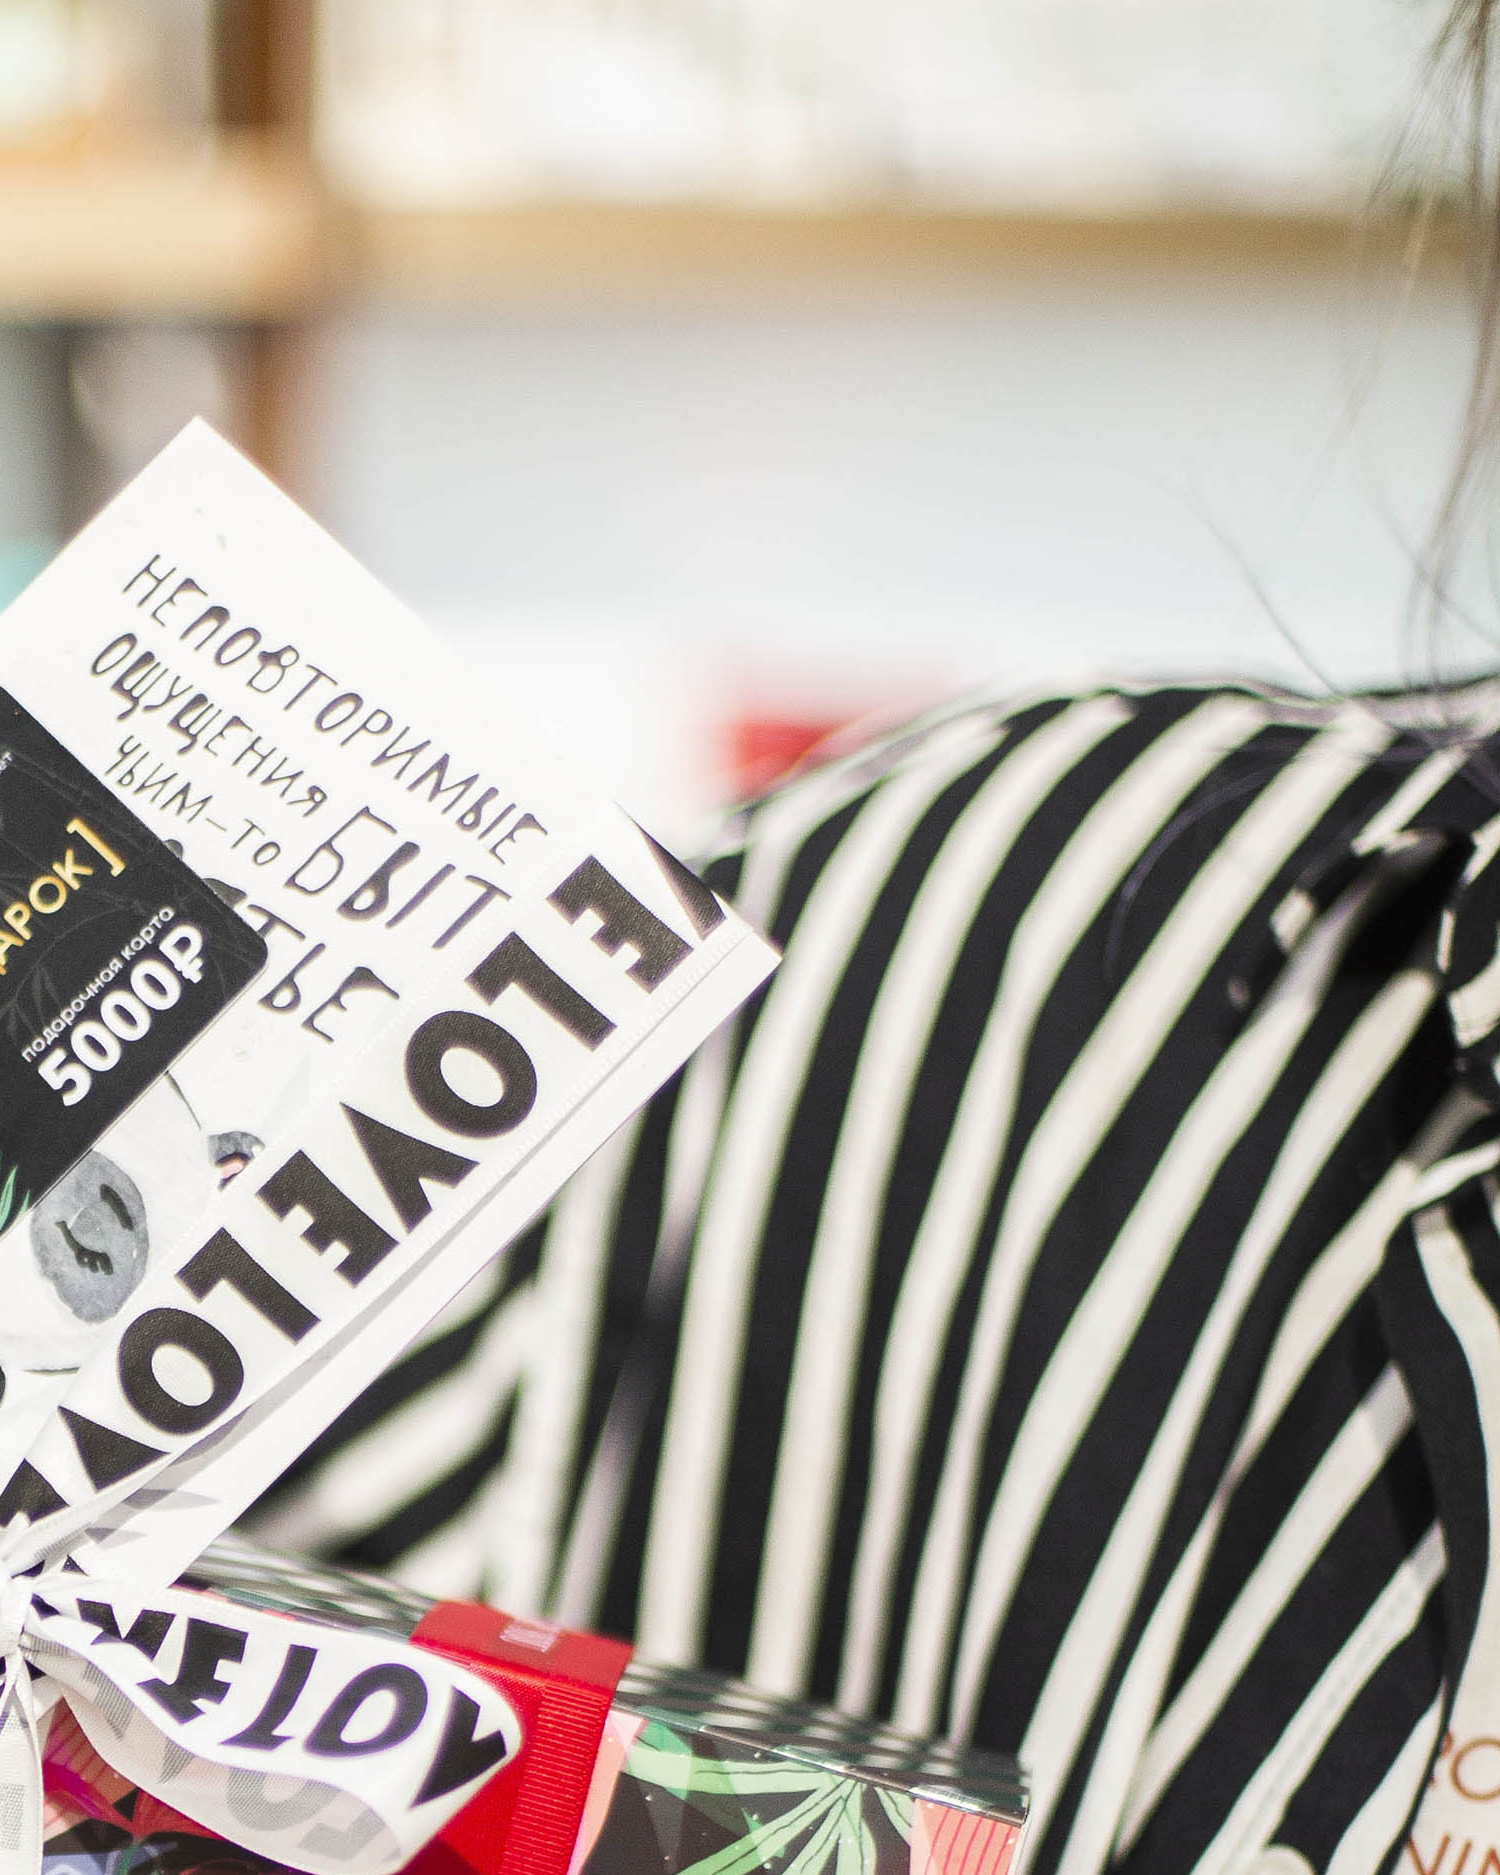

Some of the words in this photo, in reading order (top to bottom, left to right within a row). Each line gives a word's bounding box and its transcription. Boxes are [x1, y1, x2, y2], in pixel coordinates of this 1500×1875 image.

[91, 632, 328, 818] ОЩУЩЕНИЯ
[122, 553, 548, 865] НЕПОВТОРИМЫЕ
[284, 805, 512, 949] БЫТ
[21, 957, 123, 1062] подарочная
[121, 906, 175, 961] карта
